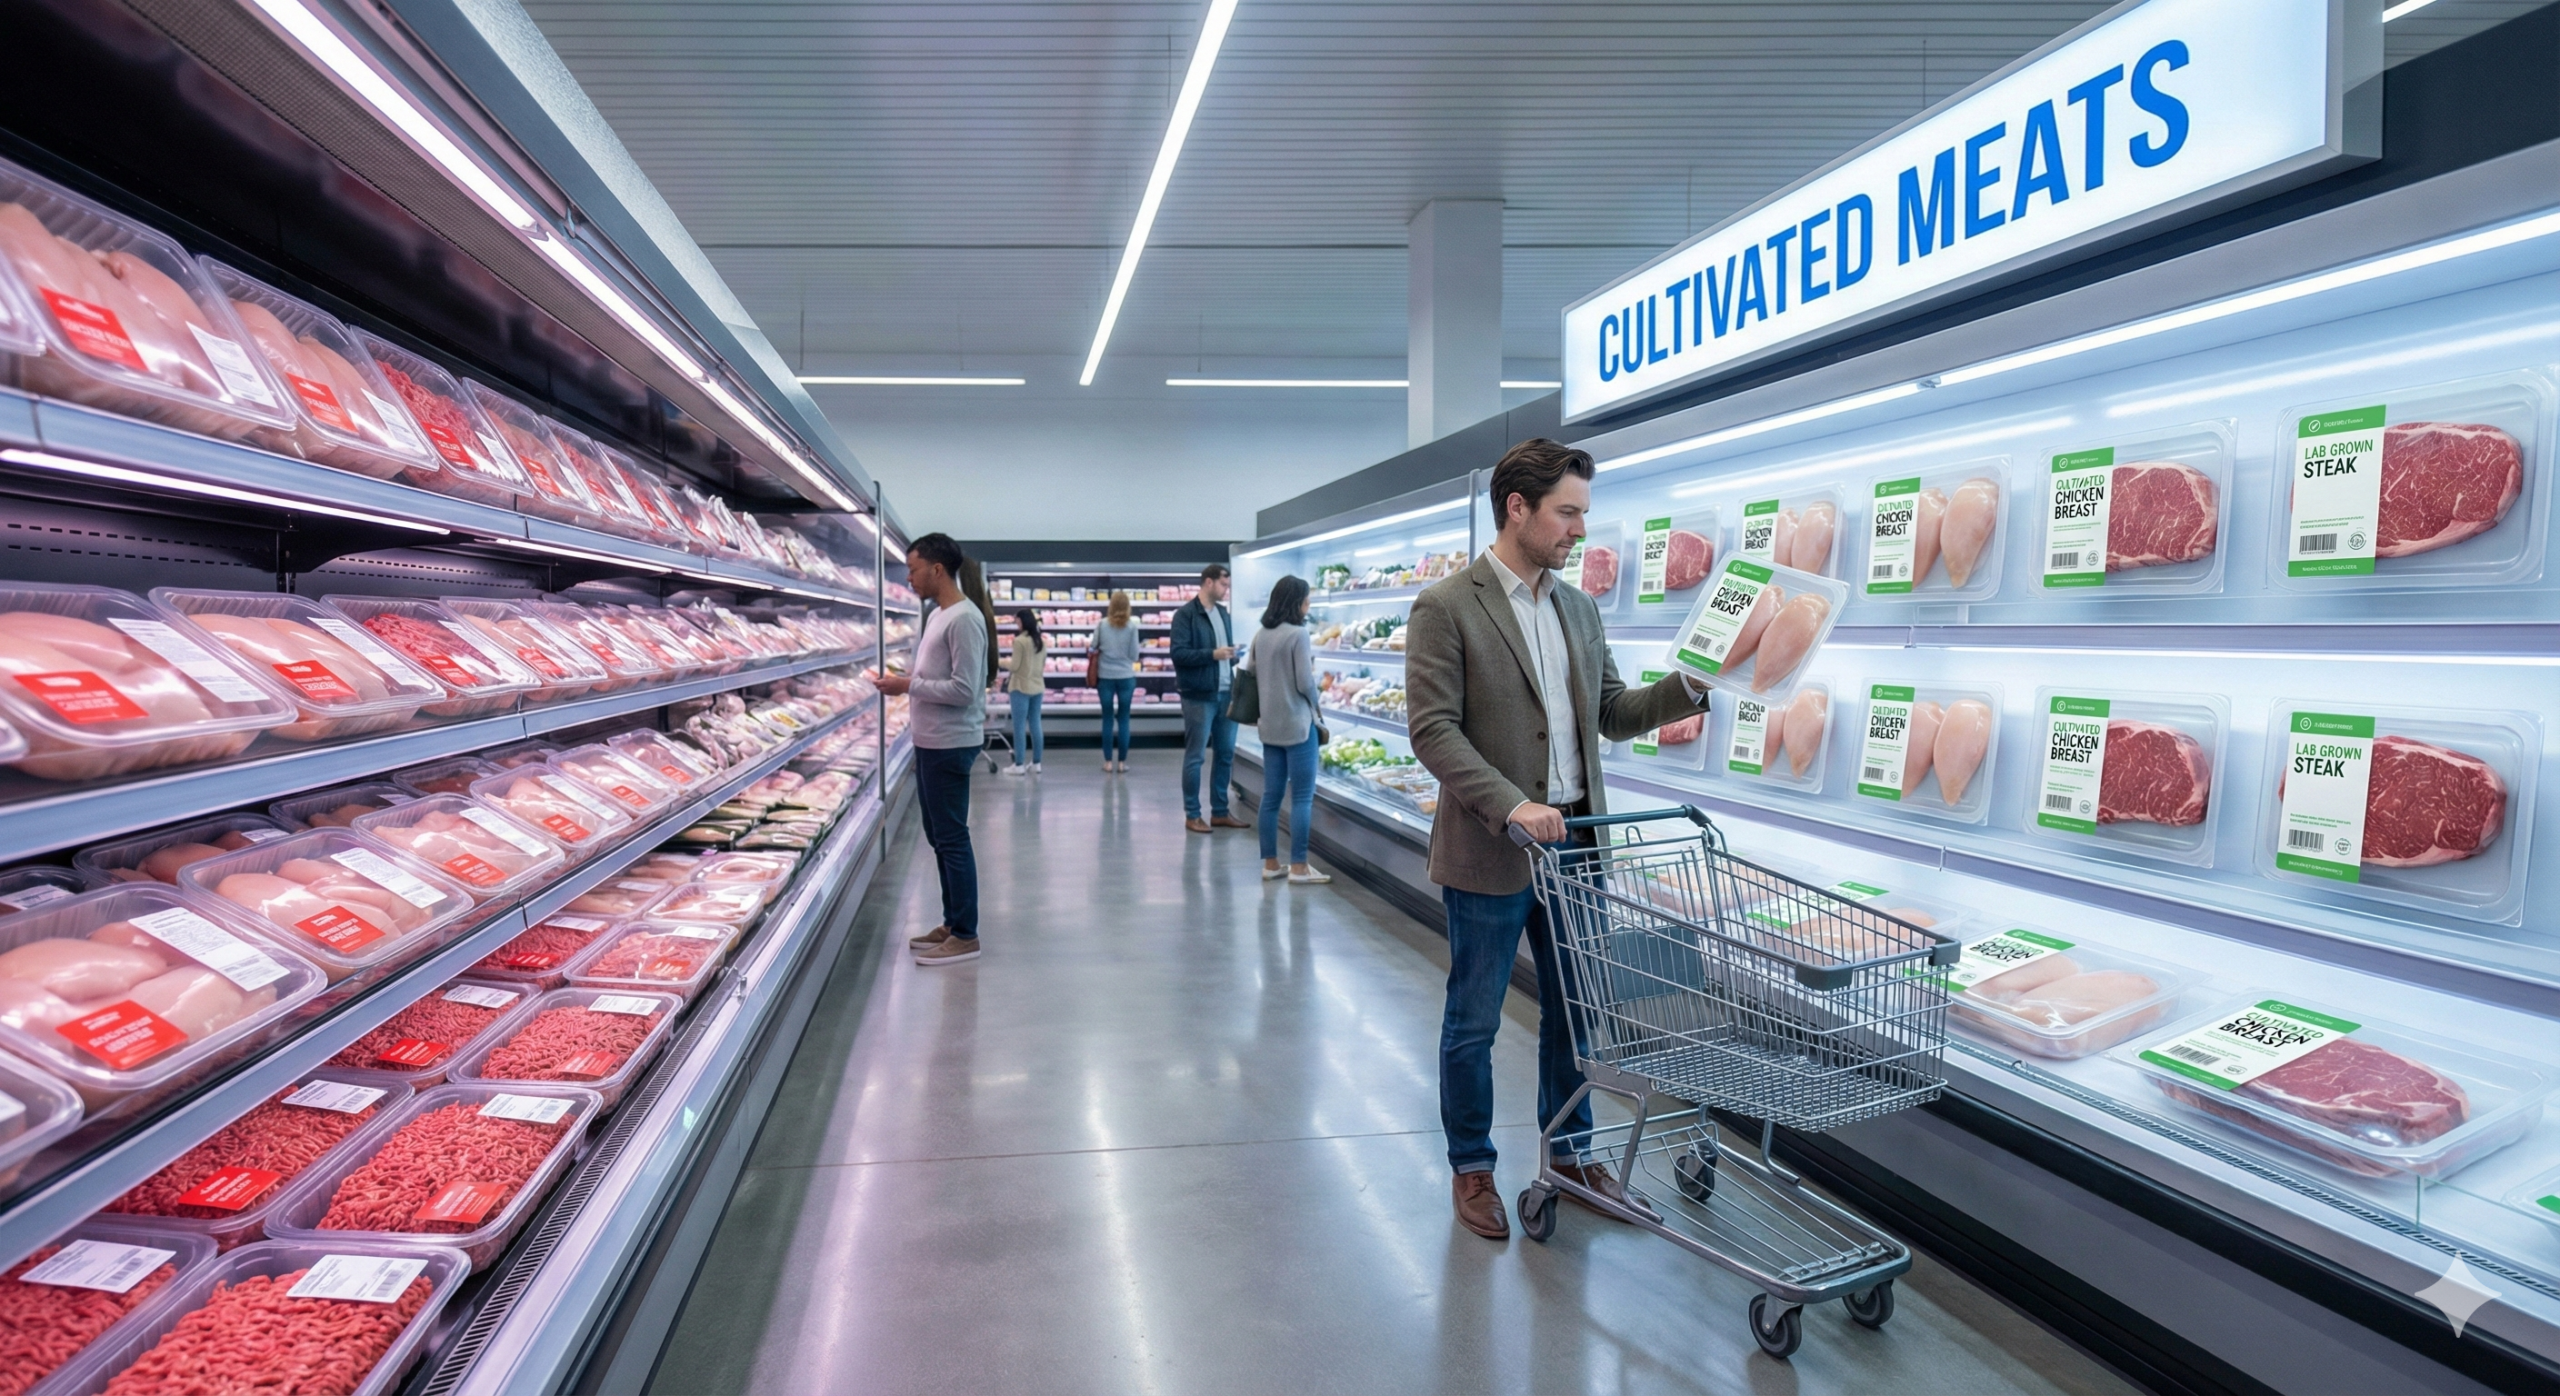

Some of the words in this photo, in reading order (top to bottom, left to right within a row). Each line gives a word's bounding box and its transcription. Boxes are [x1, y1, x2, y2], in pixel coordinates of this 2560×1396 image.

[1599, 193, 1873, 382] CULTIVATED
[1898, 39, 2190, 266] MEATS
[2305, 445, 2327, 460] LAB
[2330, 439, 2373, 456] GROWN
[2303, 456, 2358, 478] STEAK
[2055, 486, 2104, 505] CHICKEN
[2054, 502, 2098, 519] BREAST
[2052, 732, 2099, 749] CHICKEN
[2050, 747, 2092, 763] BREAST
[2296, 742, 2317, 756] LAB
[2320, 744, 2362, 760] GROWN
[2294, 756, 2345, 778] STEAK
